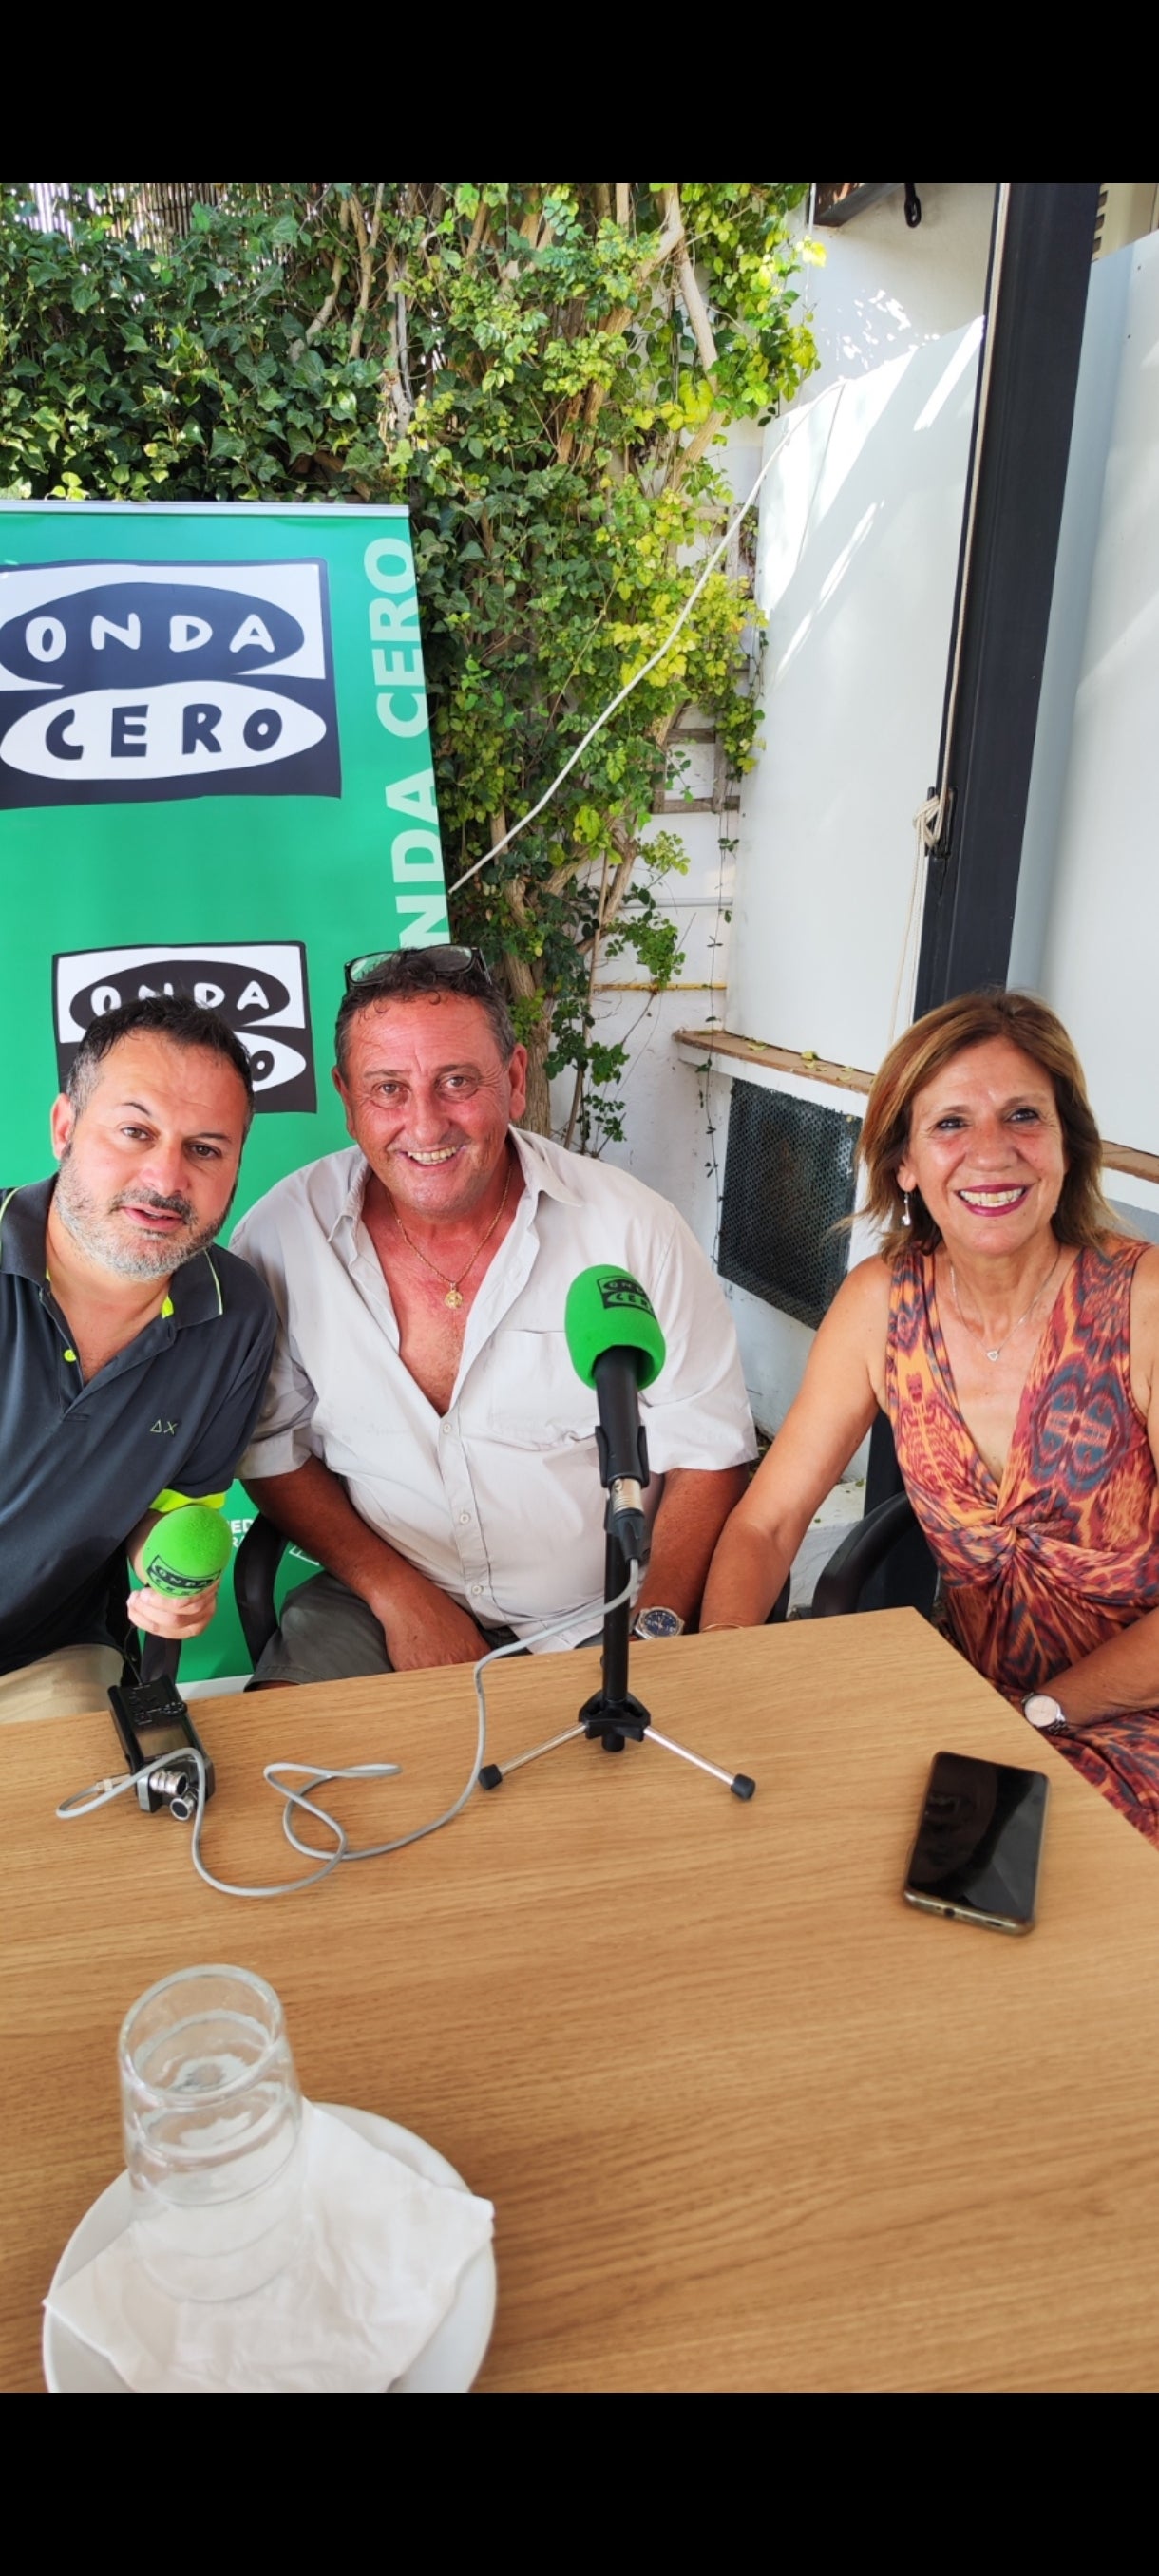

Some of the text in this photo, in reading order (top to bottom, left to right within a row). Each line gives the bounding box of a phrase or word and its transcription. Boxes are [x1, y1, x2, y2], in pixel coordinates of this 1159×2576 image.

[25, 612, 276, 663] ONDA
[45, 702, 283, 761] CERO
[364, 537, 451, 948] NDA CERO
